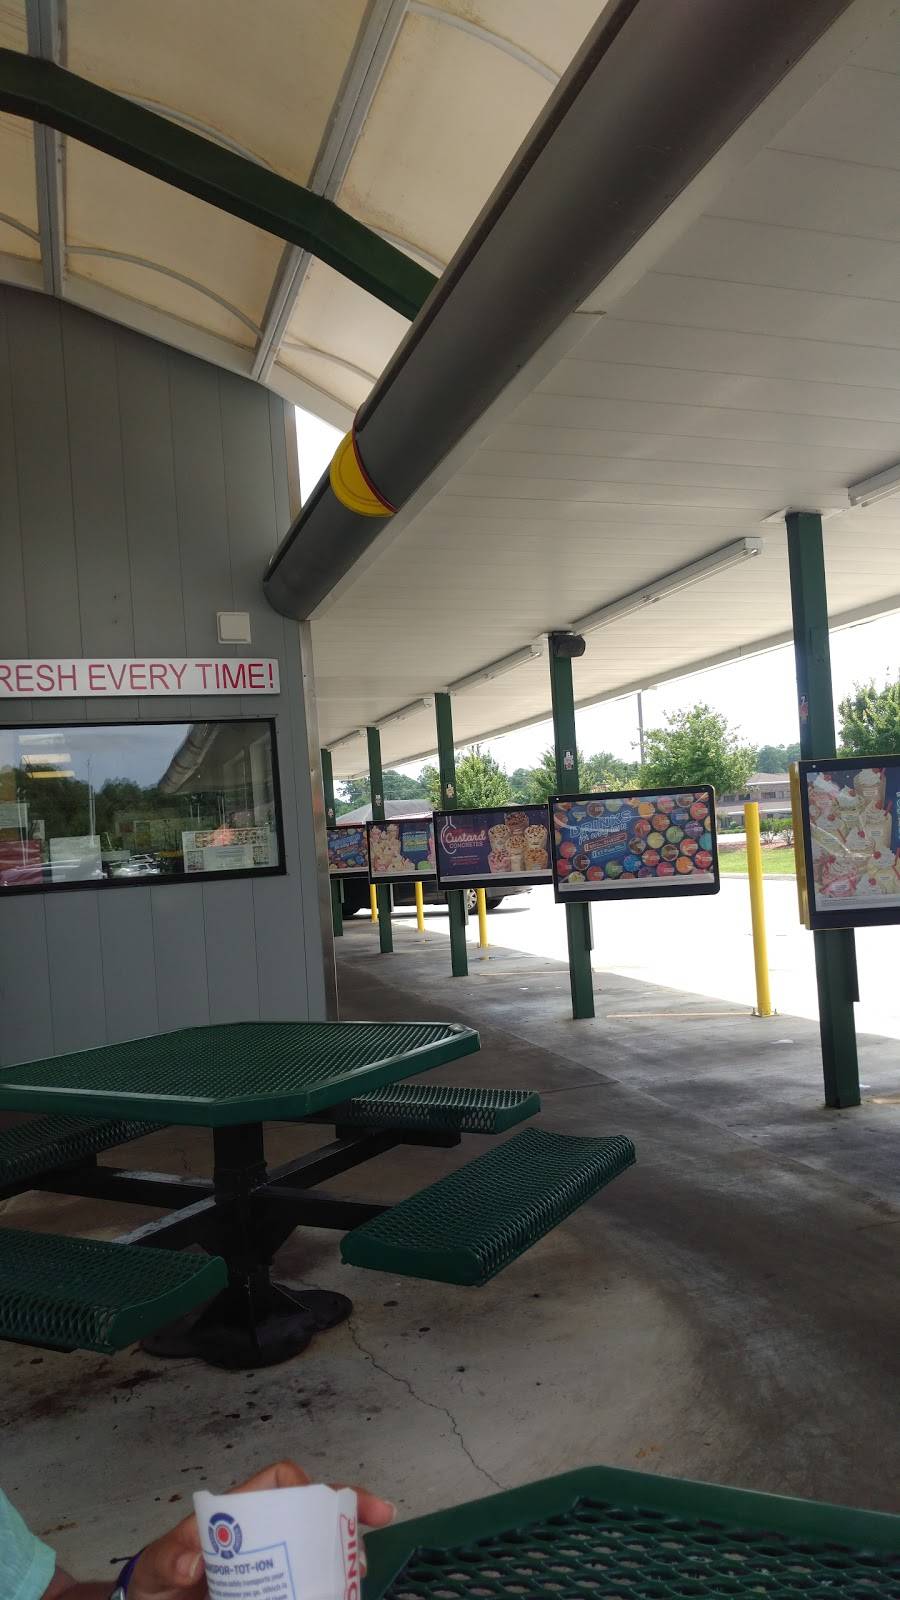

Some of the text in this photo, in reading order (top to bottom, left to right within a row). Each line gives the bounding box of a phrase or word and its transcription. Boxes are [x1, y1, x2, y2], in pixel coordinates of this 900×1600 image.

[88, 663, 187, 691] EVERY
[194, 663, 274, 689] TIME!
[446, 830, 486, 843] Custard
